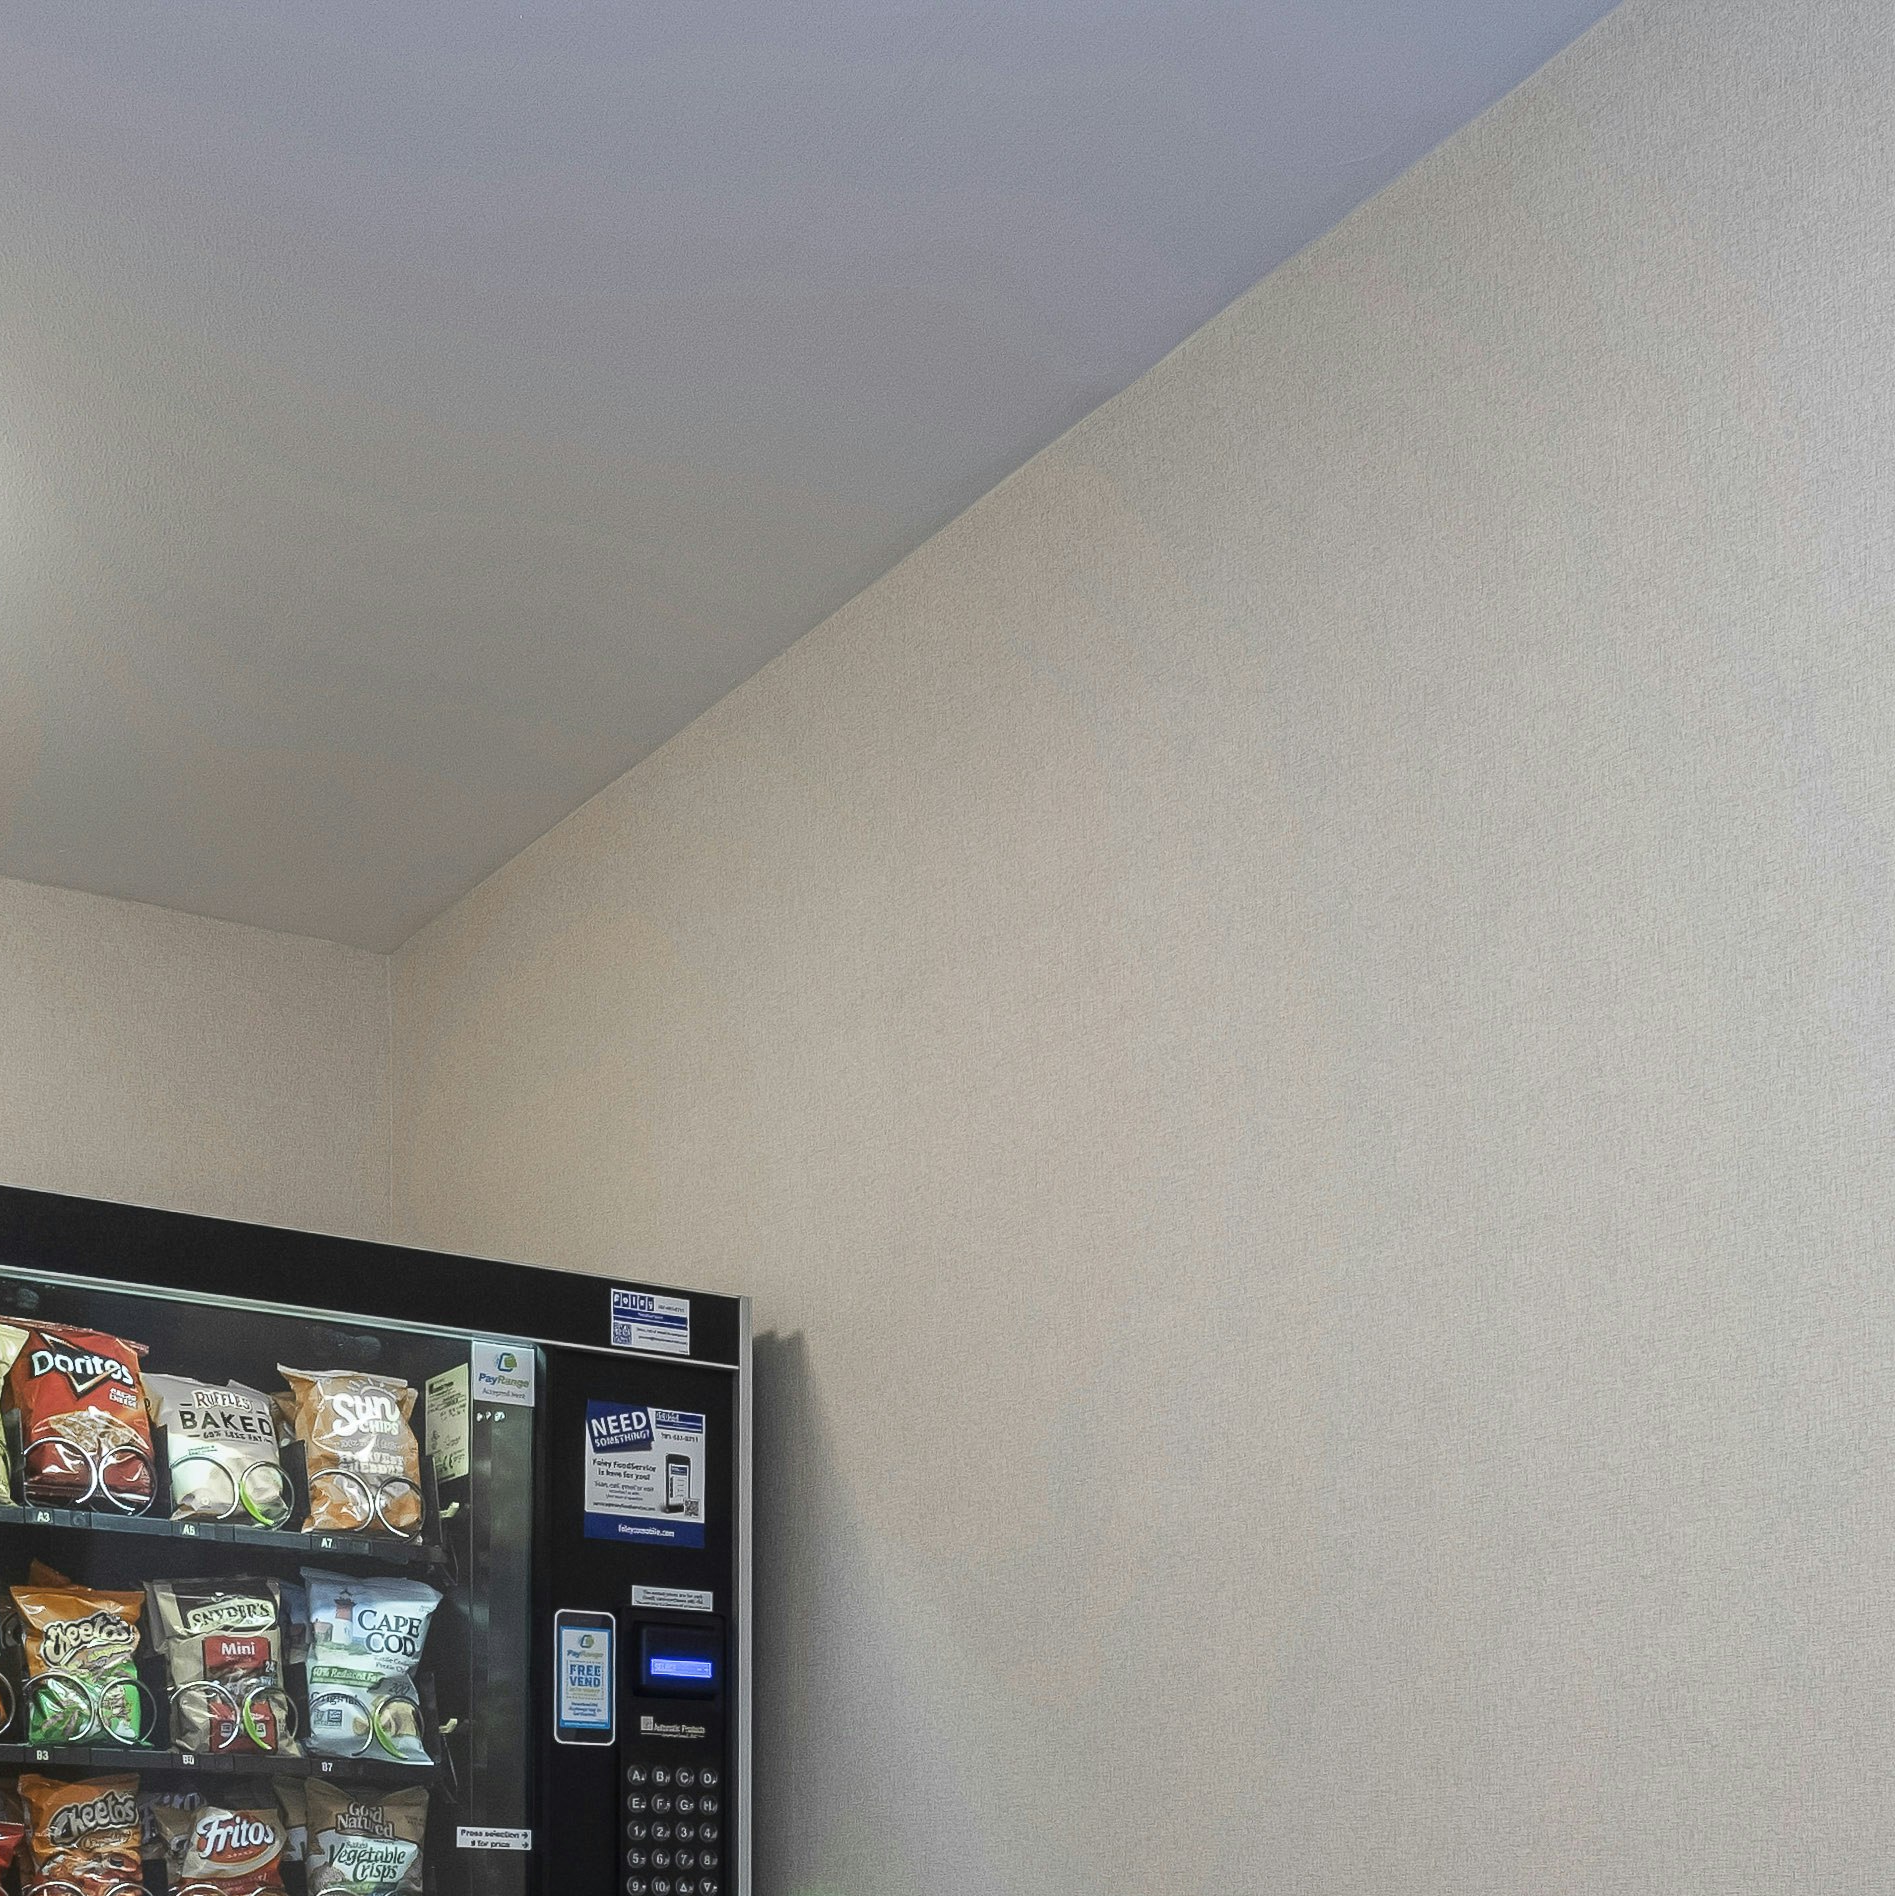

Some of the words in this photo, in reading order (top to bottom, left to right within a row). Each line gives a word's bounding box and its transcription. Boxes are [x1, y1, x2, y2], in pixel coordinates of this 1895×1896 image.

[30, 1349, 136, 1388] Doritos
[478, 1372, 530, 1389] PayRange
[194, 1390, 253, 1411] RUFFLES
[323, 1392, 401, 1437] Sun
[179, 1410, 273, 1437] BAKED
[360, 1420, 400, 1436] CHIPS
[591, 1411, 647, 1437] NEED
[594, 1429, 650, 1448] SOMETHING?
[37, 1511, 51, 1522] A3
[321, 1537, 333, 1549] A7
[191, 1602, 271, 1627] SNYDER'S
[357, 1609, 423, 1638] CAPE
[221, 1641, 256, 1656] Mini
[365, 1632, 417, 1658] COD
[569, 1664, 601, 1677] FREE
[569, 1676, 601, 1688] VEND
[632, 1770, 641, 1781] A
[656, 1771, 664, 1782] B
[680, 1772, 689, 1783] C
[703, 1773, 712, 1784] D
[632, 1798, 640, 1809] E
[679, 1799, 689, 1810] G
[49, 1790, 138, 1847] Cheetos
[335, 1813, 396, 1840] Natured
[633, 1825, 639, 1836] 1
[656, 1826, 664, 1837] 2
[680, 1826, 688, 1838] 3
[196, 1813, 275, 1858] Fritos
[704, 1828, 711, 1839] 4
[329, 1841, 406, 1870] Vegetable
[632, 1853, 639, 1864] 5
[656, 1853, 663, 1865] 6
[680, 1854, 688, 1865] 7
[704, 1855, 711, 1865] 8
[353, 1860, 399, 1884] Crisps
[632, 1881, 639, 1892] 9
[655, 1881, 666, 1892] 10
